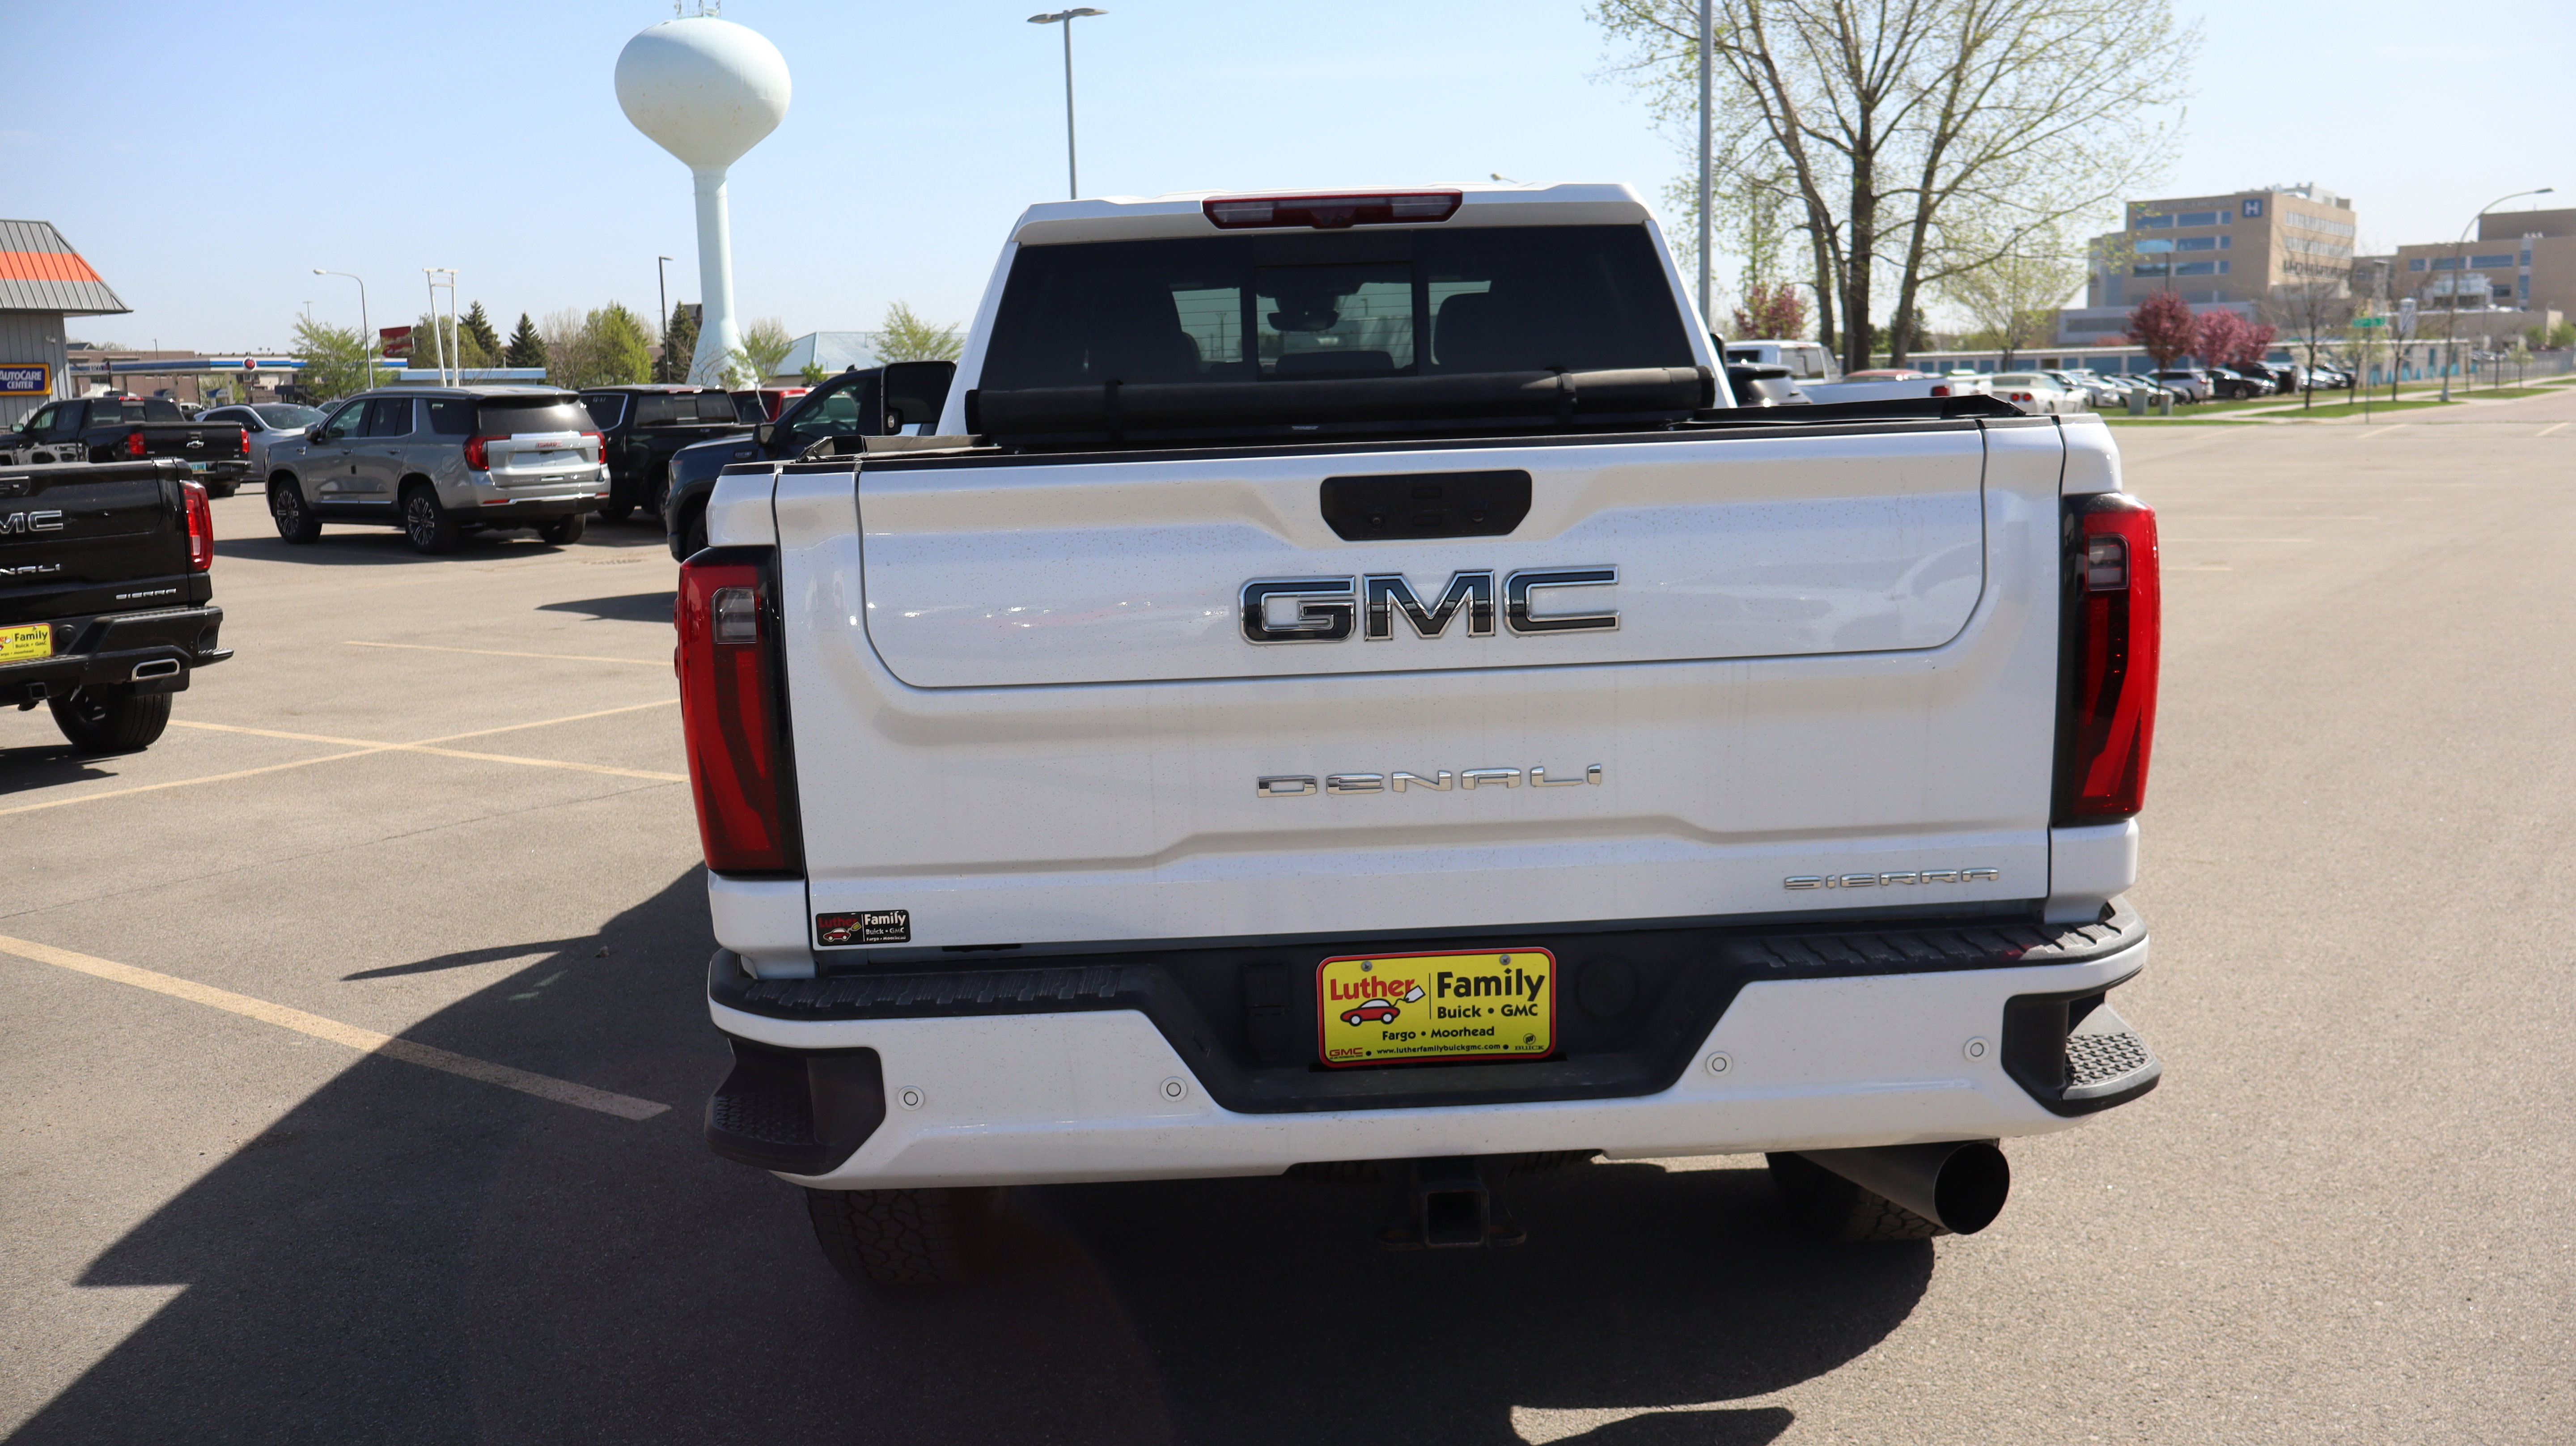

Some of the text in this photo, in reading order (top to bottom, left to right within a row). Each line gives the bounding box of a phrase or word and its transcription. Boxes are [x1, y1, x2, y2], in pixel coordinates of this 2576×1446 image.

[2245, 202, 2260, 216] H
[7, 381, 34, 389] CENTER
[0, 510, 64, 534] MC
[0, 563, 60, 575] NALI
[116, 588, 176, 600] SIERRA
[1238, 564, 1620, 644] GMC
[14, 631, 48, 641] Family
[1257, 763, 1602, 797] DENALI
[1784, 868, 1999, 890] SIERRA
[818, 912, 906, 928] Luther Family
[1330, 968, 1545, 1001] Luther Family
[1437, 1004, 1538, 1018] Buick GMC
[1382, 1026, 1495, 1041] Fargo Moorhead
[1330, 1047, 1363, 1056] GMC
[1377, 1044, 1500, 1054] www.lutherfamilybuickgmc.com
